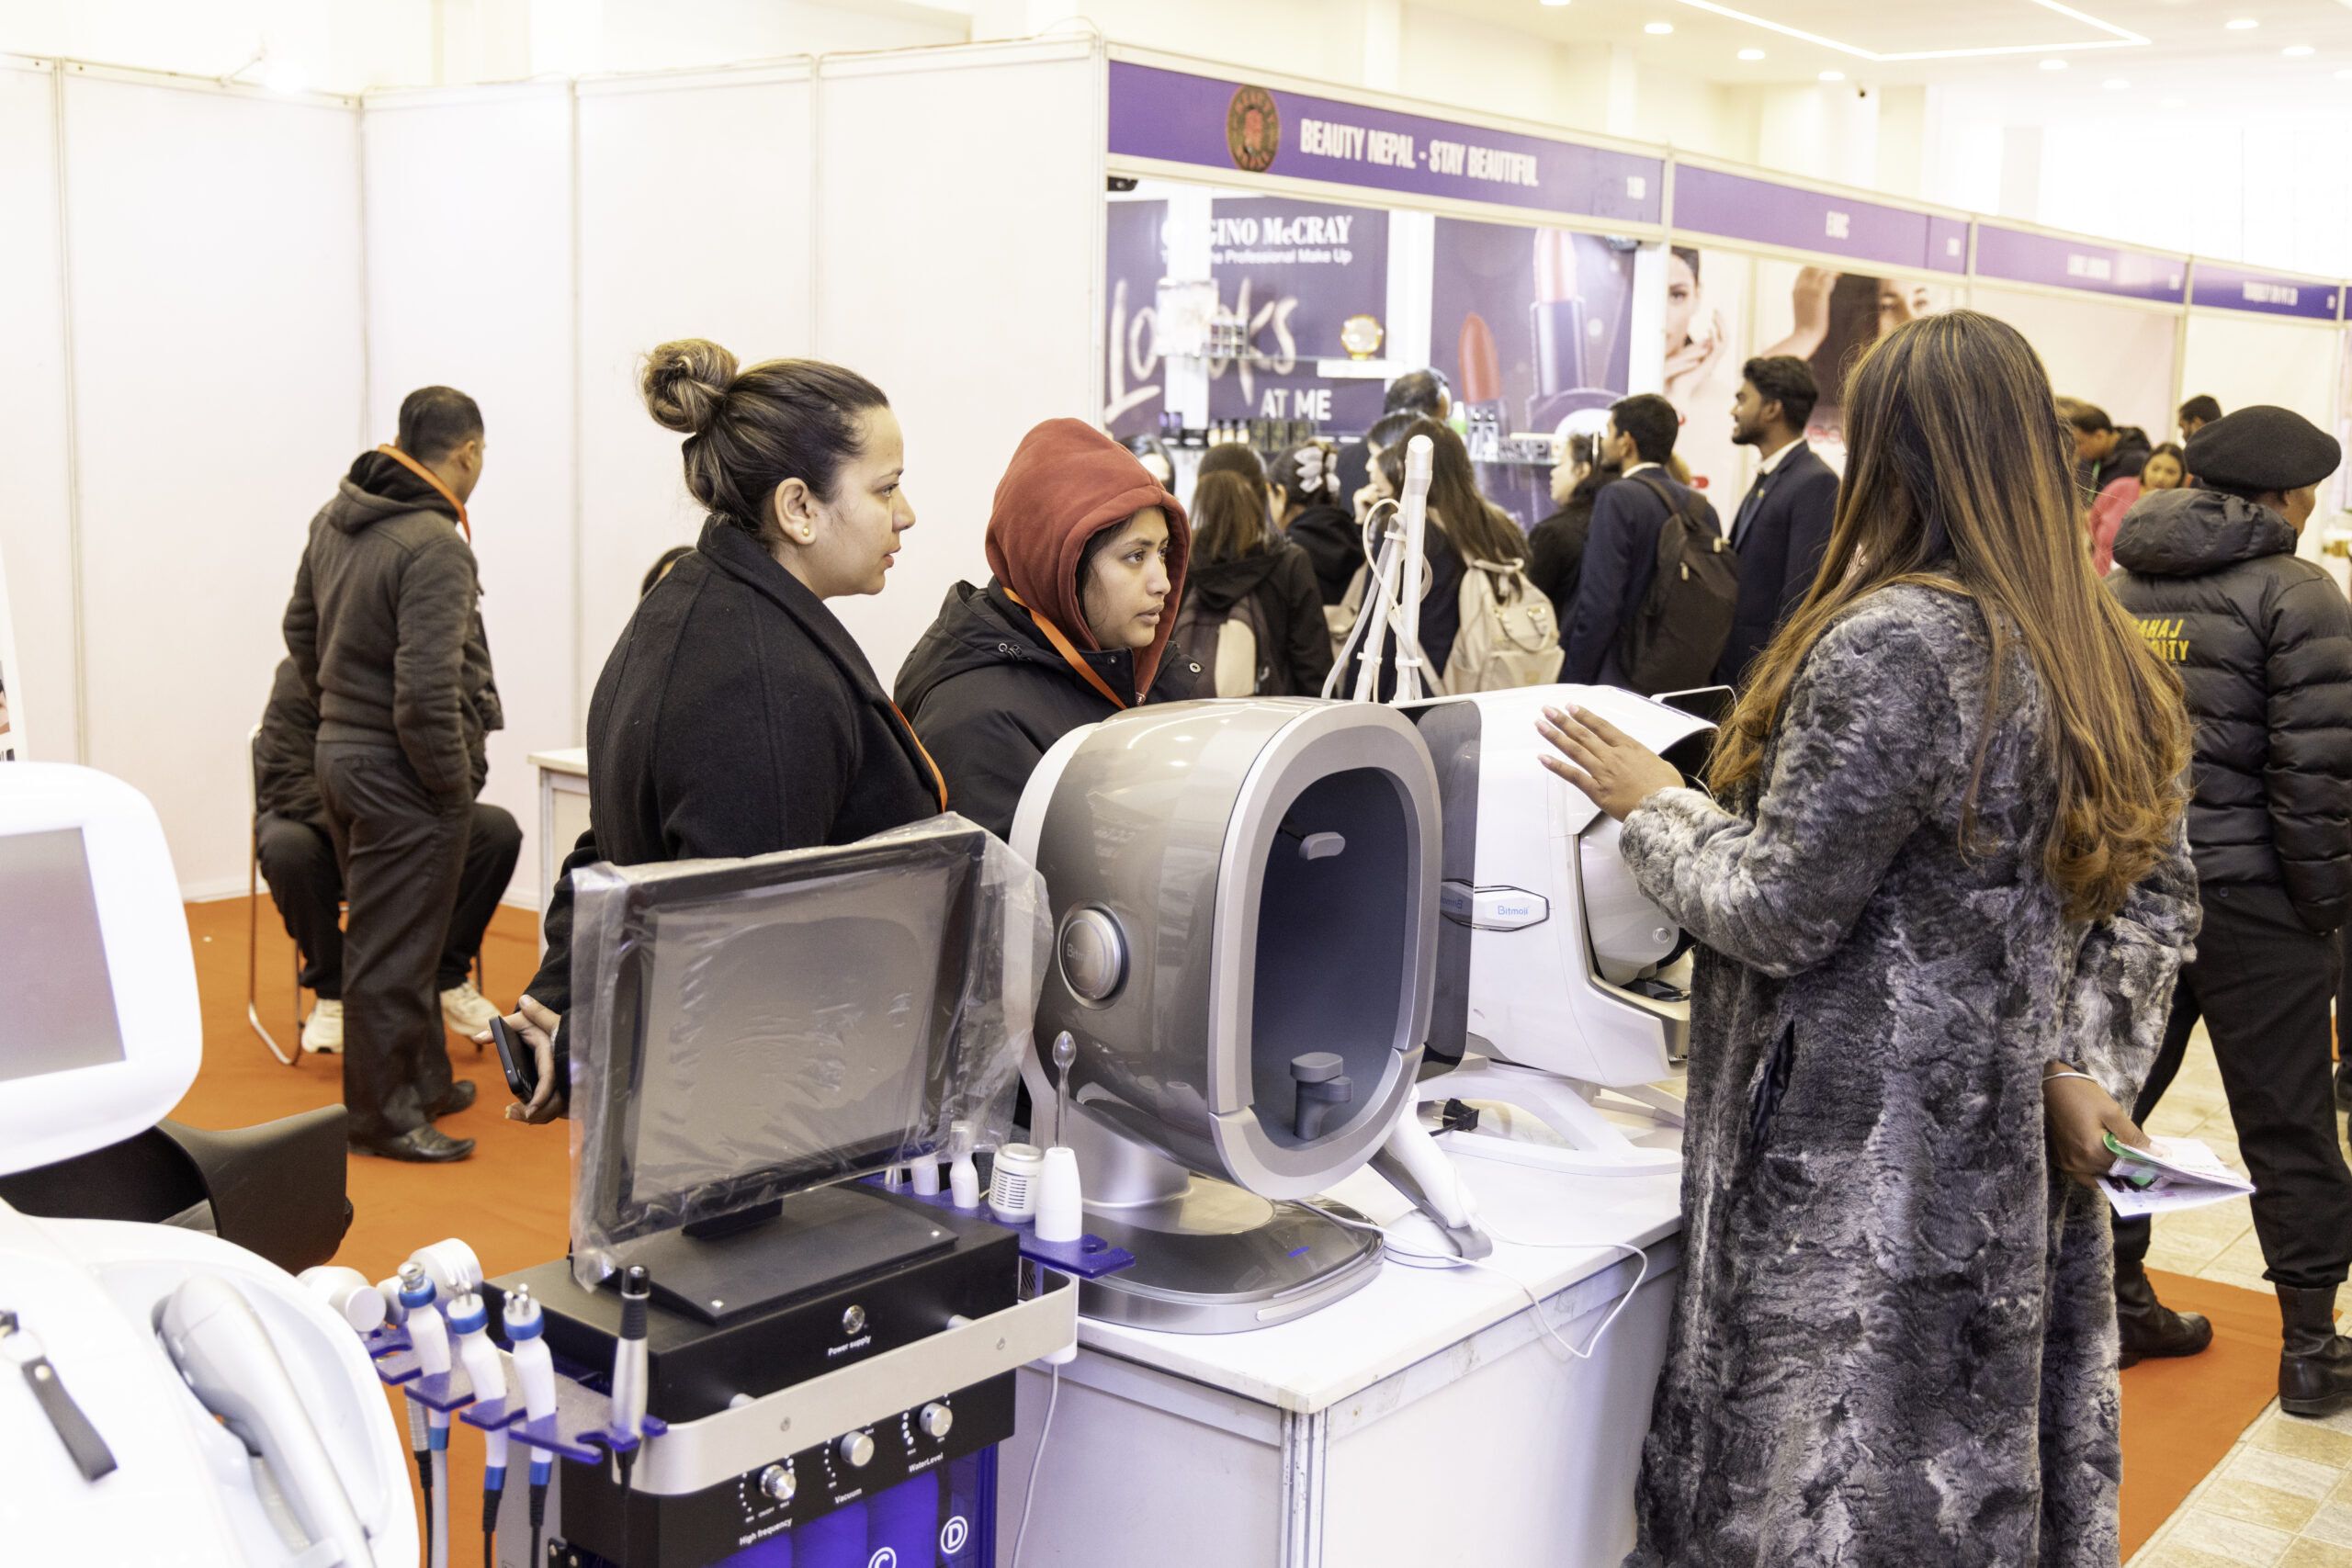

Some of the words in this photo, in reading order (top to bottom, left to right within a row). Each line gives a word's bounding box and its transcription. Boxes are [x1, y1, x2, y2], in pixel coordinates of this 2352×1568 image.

[1300, 118, 1365, 161] BEAUTY
[1367, 129, 1417, 169] NEPAL
[1428, 139, 1465, 176] STAY
[1467, 145, 1539, 187] BEAUTIFUL
[1261, 215, 1353, 245] McCRAY
[1333, 248, 1353, 265] Up
[1260, 387, 1289, 420] AT
[1294, 389, 1332, 422] ME
[828, 1343, 849, 1357] Power
[849, 1335, 872, 1348] supply
[908, 1451, 944, 1473] WaterLevel
[834, 1487, 863, 1505] Vacuum
[739, 1532, 757, 1546] High
[757, 1517, 793, 1538] frequency
